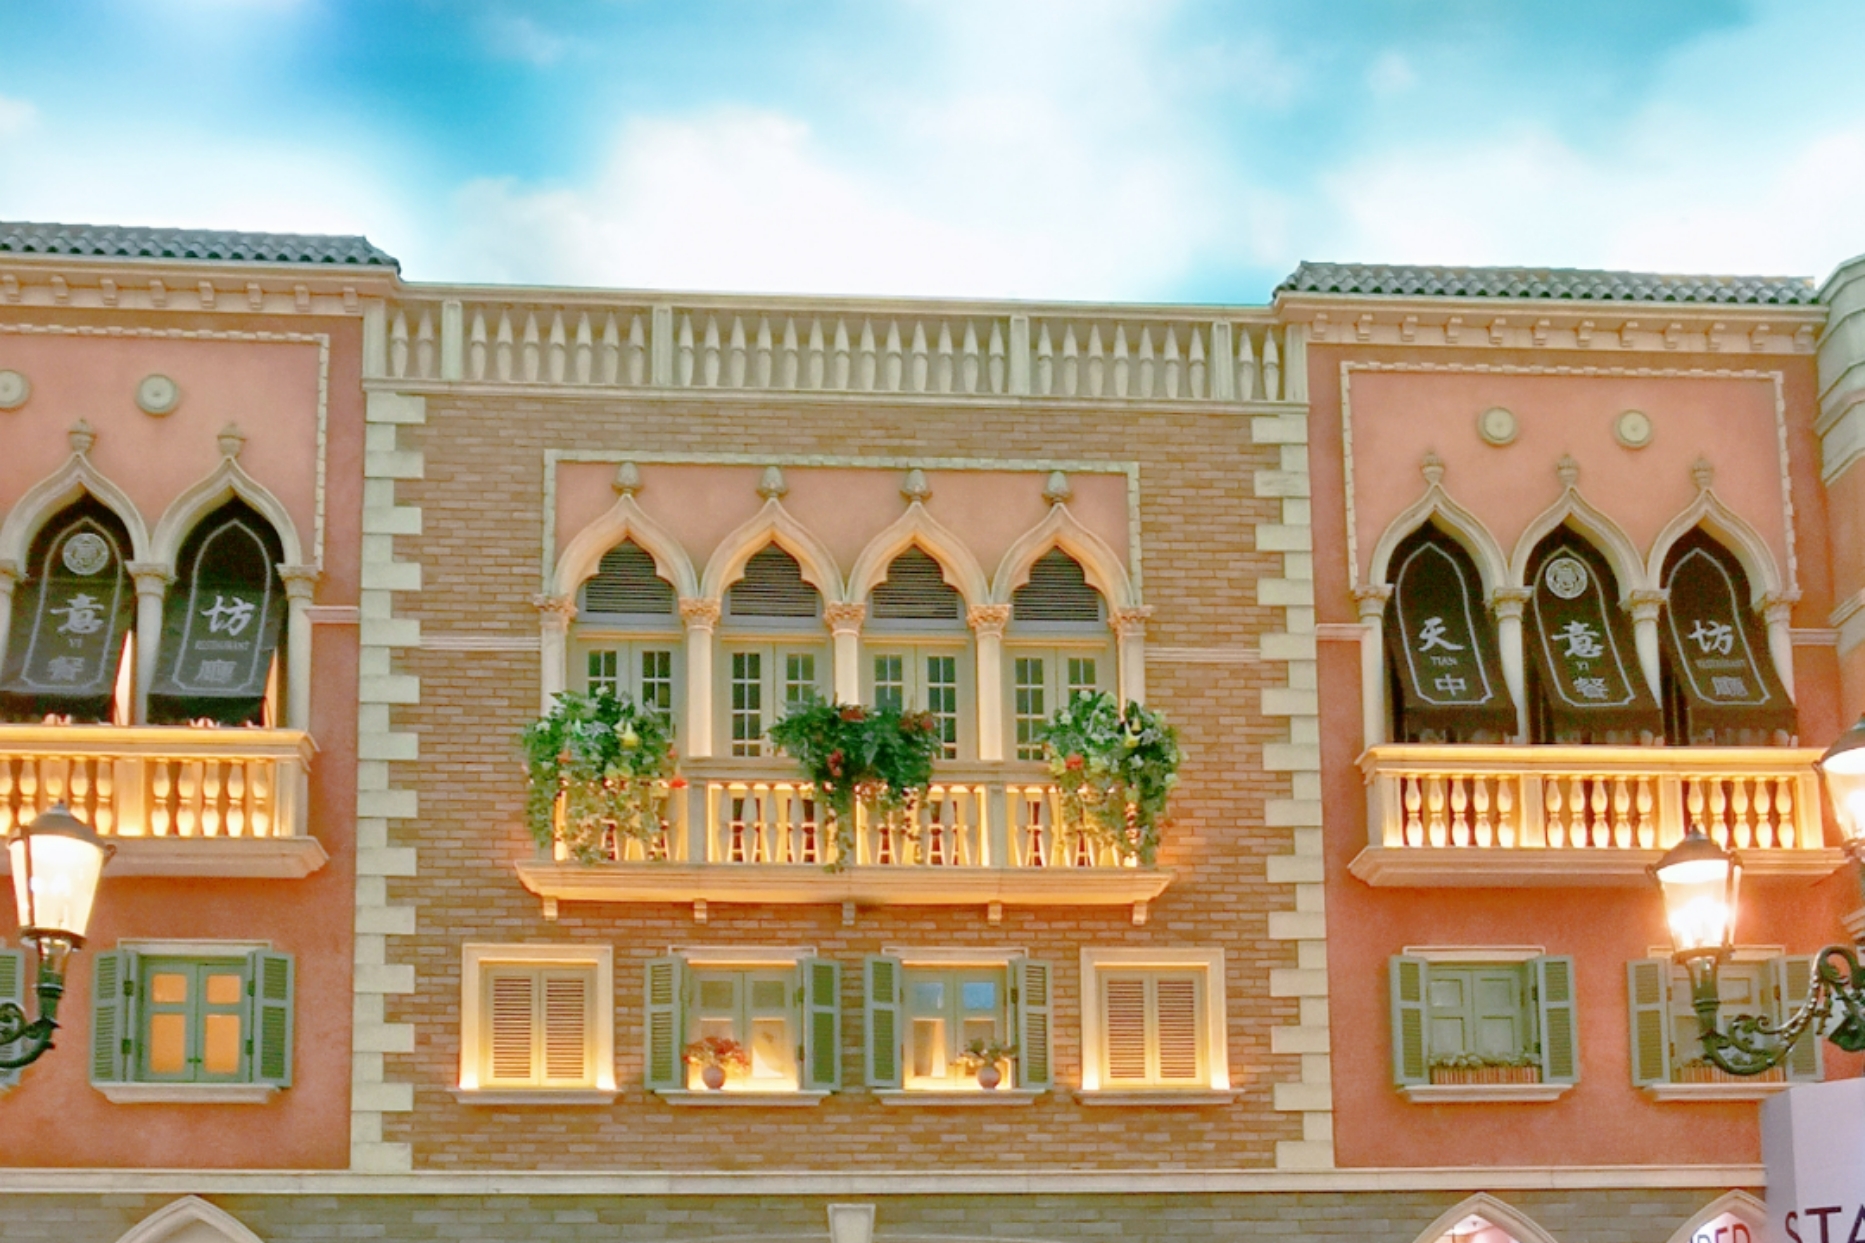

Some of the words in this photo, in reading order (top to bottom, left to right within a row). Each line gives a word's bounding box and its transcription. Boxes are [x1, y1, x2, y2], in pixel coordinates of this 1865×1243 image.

[49, 593, 104, 634] 意
[200, 595, 255, 636] 坊
[1418, 616, 1464, 652] 天
[1551, 620, 1604, 658] 意
[1688, 619, 1734, 655] 坊
[1434, 673, 1467, 696] 中
